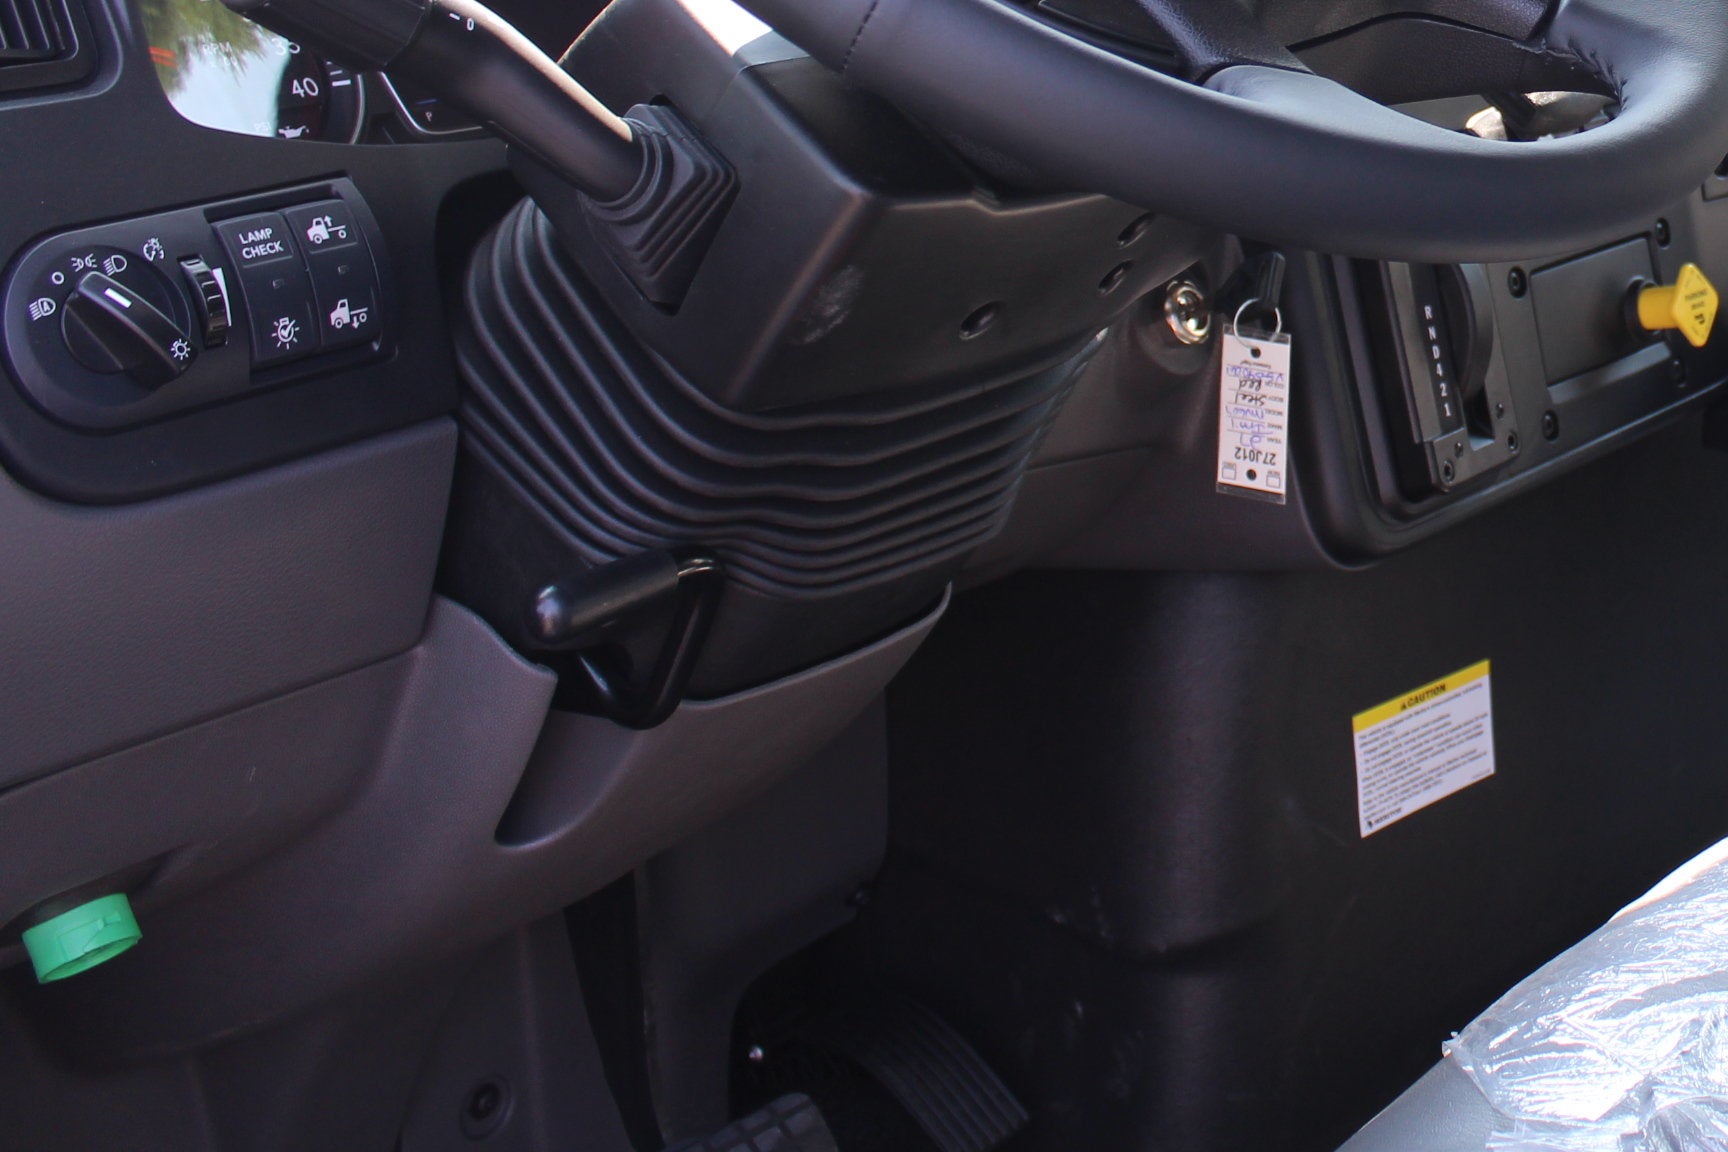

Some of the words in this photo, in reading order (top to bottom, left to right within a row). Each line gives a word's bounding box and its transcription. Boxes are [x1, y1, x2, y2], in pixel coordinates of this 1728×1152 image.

[292, 77, 319, 98] 40
[239, 227, 274, 245] LAMP
[242, 241, 283, 259] CHECK
[1424, 305, 1432, 319] R
[1428, 326, 1436, 340] N
[1432, 345, 1440, 359] D
[1440, 382, 1448, 397] 2
[1444, 403, 1451, 416] 1
[1239, 378, 1262, 390] Red
[1234, 447, 1276, 465] 27J012
[1407, 683, 1447, 708] CAUTION
